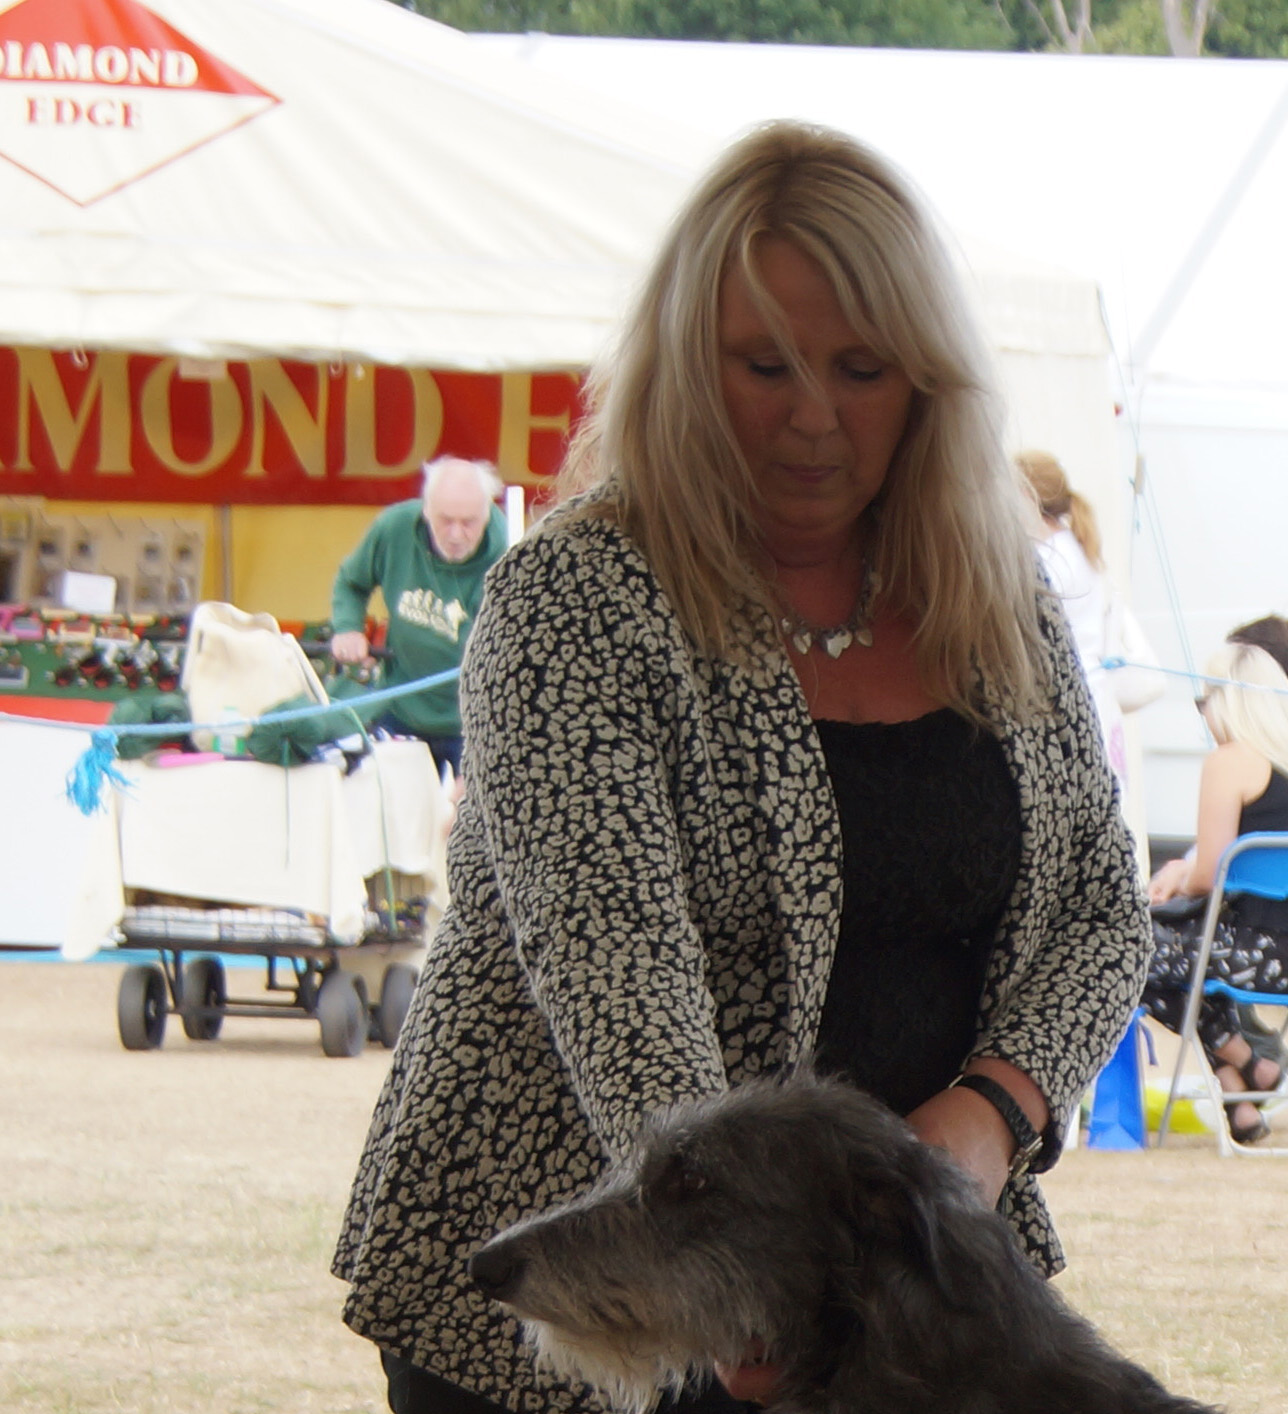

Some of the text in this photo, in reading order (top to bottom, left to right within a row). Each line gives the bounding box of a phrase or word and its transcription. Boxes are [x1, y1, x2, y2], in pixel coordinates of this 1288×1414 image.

[0, 39, 199, 88] IAMOND
[26, 97, 141, 130] EDGE
[0, 345, 582, 485] MOND E
